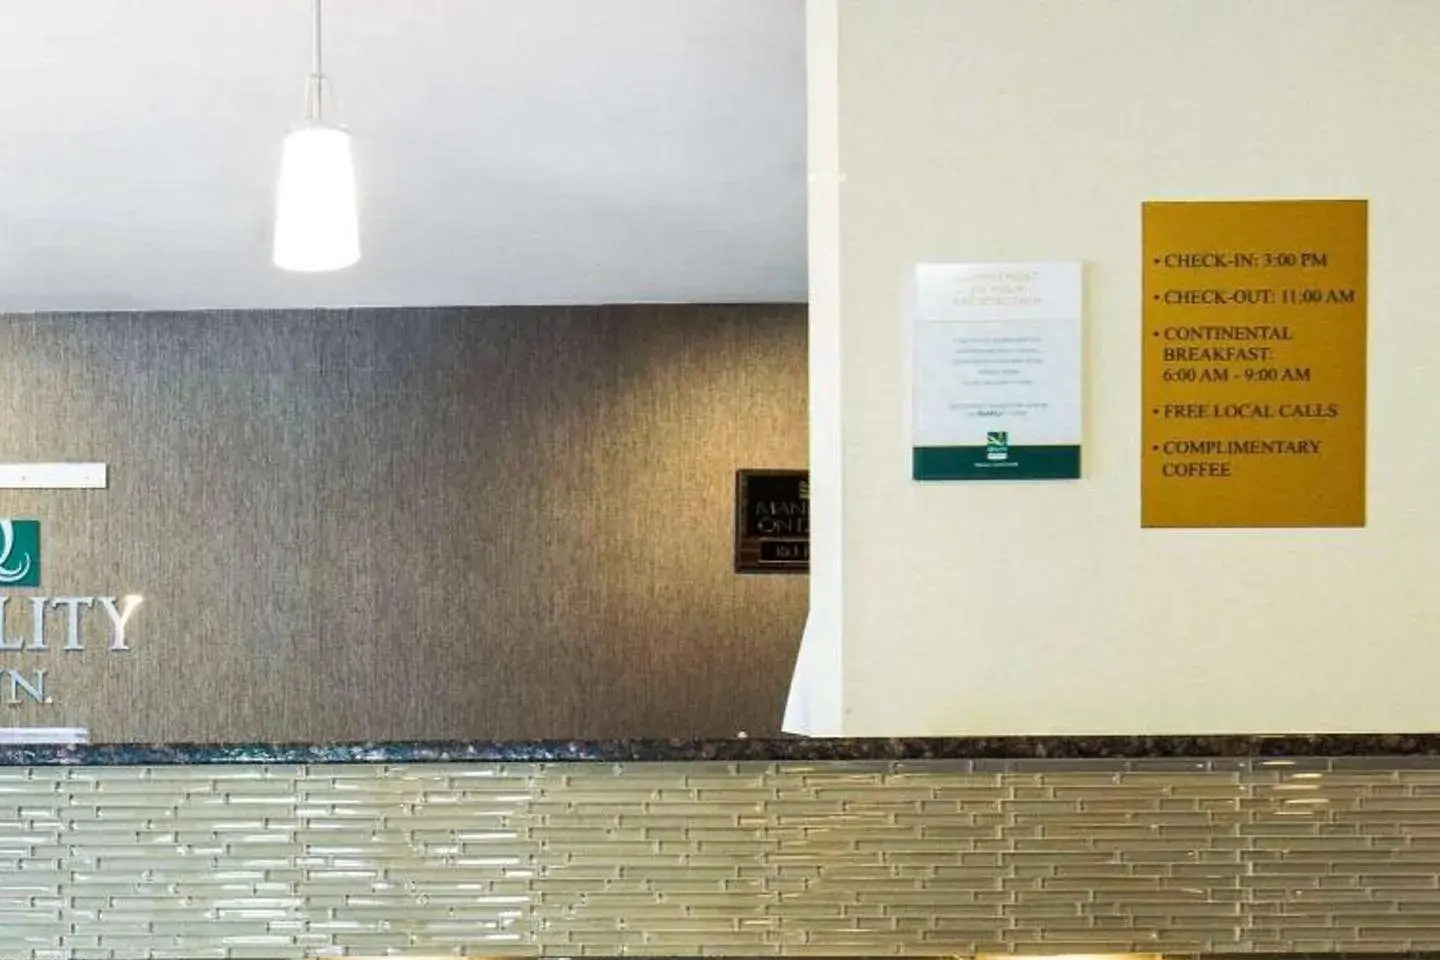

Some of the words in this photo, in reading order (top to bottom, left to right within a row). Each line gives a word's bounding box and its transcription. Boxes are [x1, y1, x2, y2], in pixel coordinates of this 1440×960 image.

[1164, 252, 1260, 268] CHECK-IN:
[1263, 252, 1296, 268] 3:00
[1301, 252, 1327, 268] PM
[1164, 289, 1276, 304] CHECK-OUT:
[1282, 289, 1322, 304] 11:00
[1325, 289, 1355, 304] AM
[1163, 326, 1293, 340] CONTINENTAL
[1163, 347, 1274, 362] BREAKFAST:
[1163, 368, 1196, 382] 6:00
[1199, 368, 1228, 382] AM
[1244, 368, 1278, 382] 9:00
[1281, 368, 1311, 382] AM
[1164, 404, 1210, 418] FREE
[1213, 404, 1274, 418] LOCAL
[1278, 403, 1338, 417] CALLS
[1162, 440, 1321, 454] COMPLIMENTARY
[1162, 462, 1231, 477] COFFEE
